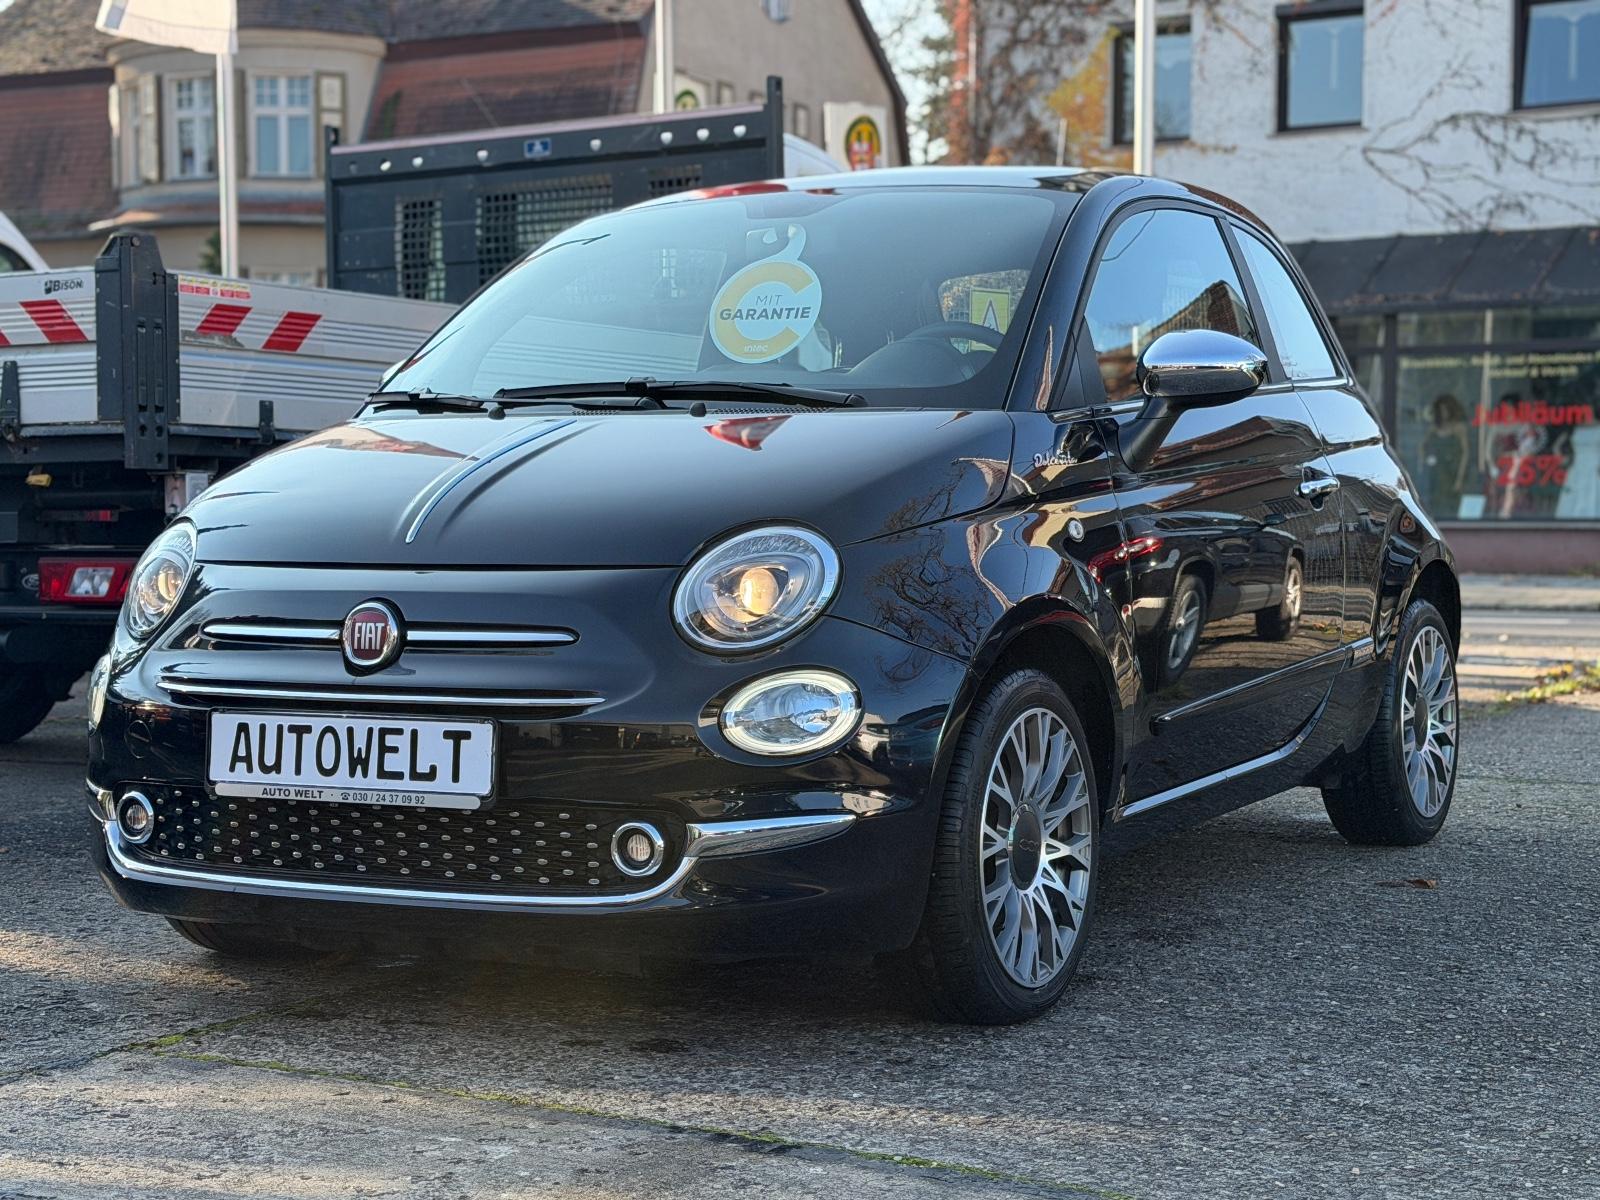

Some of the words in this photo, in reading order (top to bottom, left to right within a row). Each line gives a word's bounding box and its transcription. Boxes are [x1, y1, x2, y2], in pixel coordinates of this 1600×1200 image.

[755, 294, 783, 306] MIT
[719, 306, 811, 321] GARANTIE
[1472, 400, 1594, 427] Jubiläum
[353, 622, 386, 650] FIAT
[228, 721, 472, 784] AUTOWELT
[261, 787, 291, 798] AUTO
[294, 788, 324, 799] WELT
[352, 792, 368, 801] 030
[375, 793, 387, 802] 24
[388, 794, 400, 803] 37
[401, 795, 413, 804] 09
[414, 796, 426, 805] 92
